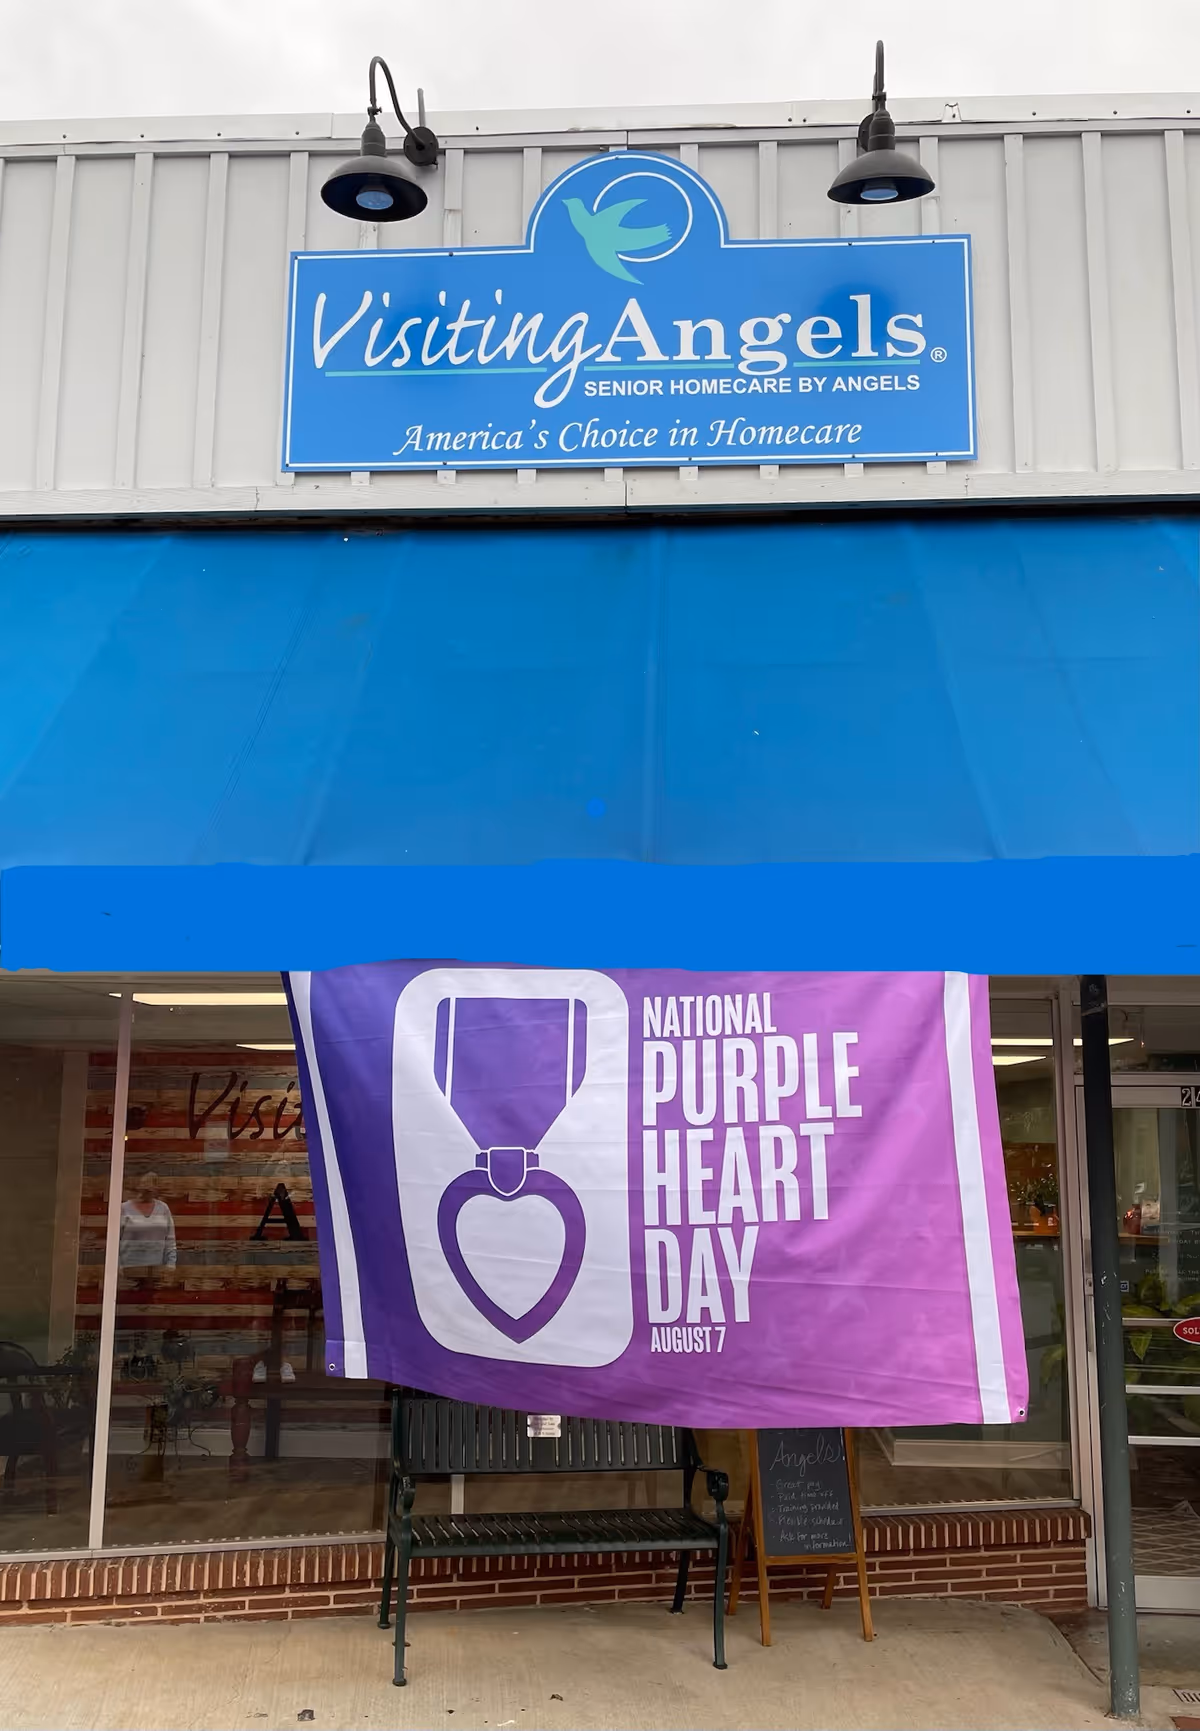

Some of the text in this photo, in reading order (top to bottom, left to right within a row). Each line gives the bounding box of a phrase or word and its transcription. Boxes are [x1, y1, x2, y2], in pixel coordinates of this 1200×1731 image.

[314, 289, 602, 409] Visiting
[594, 294, 928, 376] Angels
[584, 374, 921, 398] SENIOR HOMECARE BY ANGELS
[392, 416, 863, 456] America’s Choice in Homecare
[642, 991, 778, 1038] NATIONAL
[642, 1031, 863, 1127] PURPLE
[642, 1121, 835, 1226] HEART
[643, 1225, 760, 1325] DAY
[650, 1326, 727, 1354] AUGUST 7
